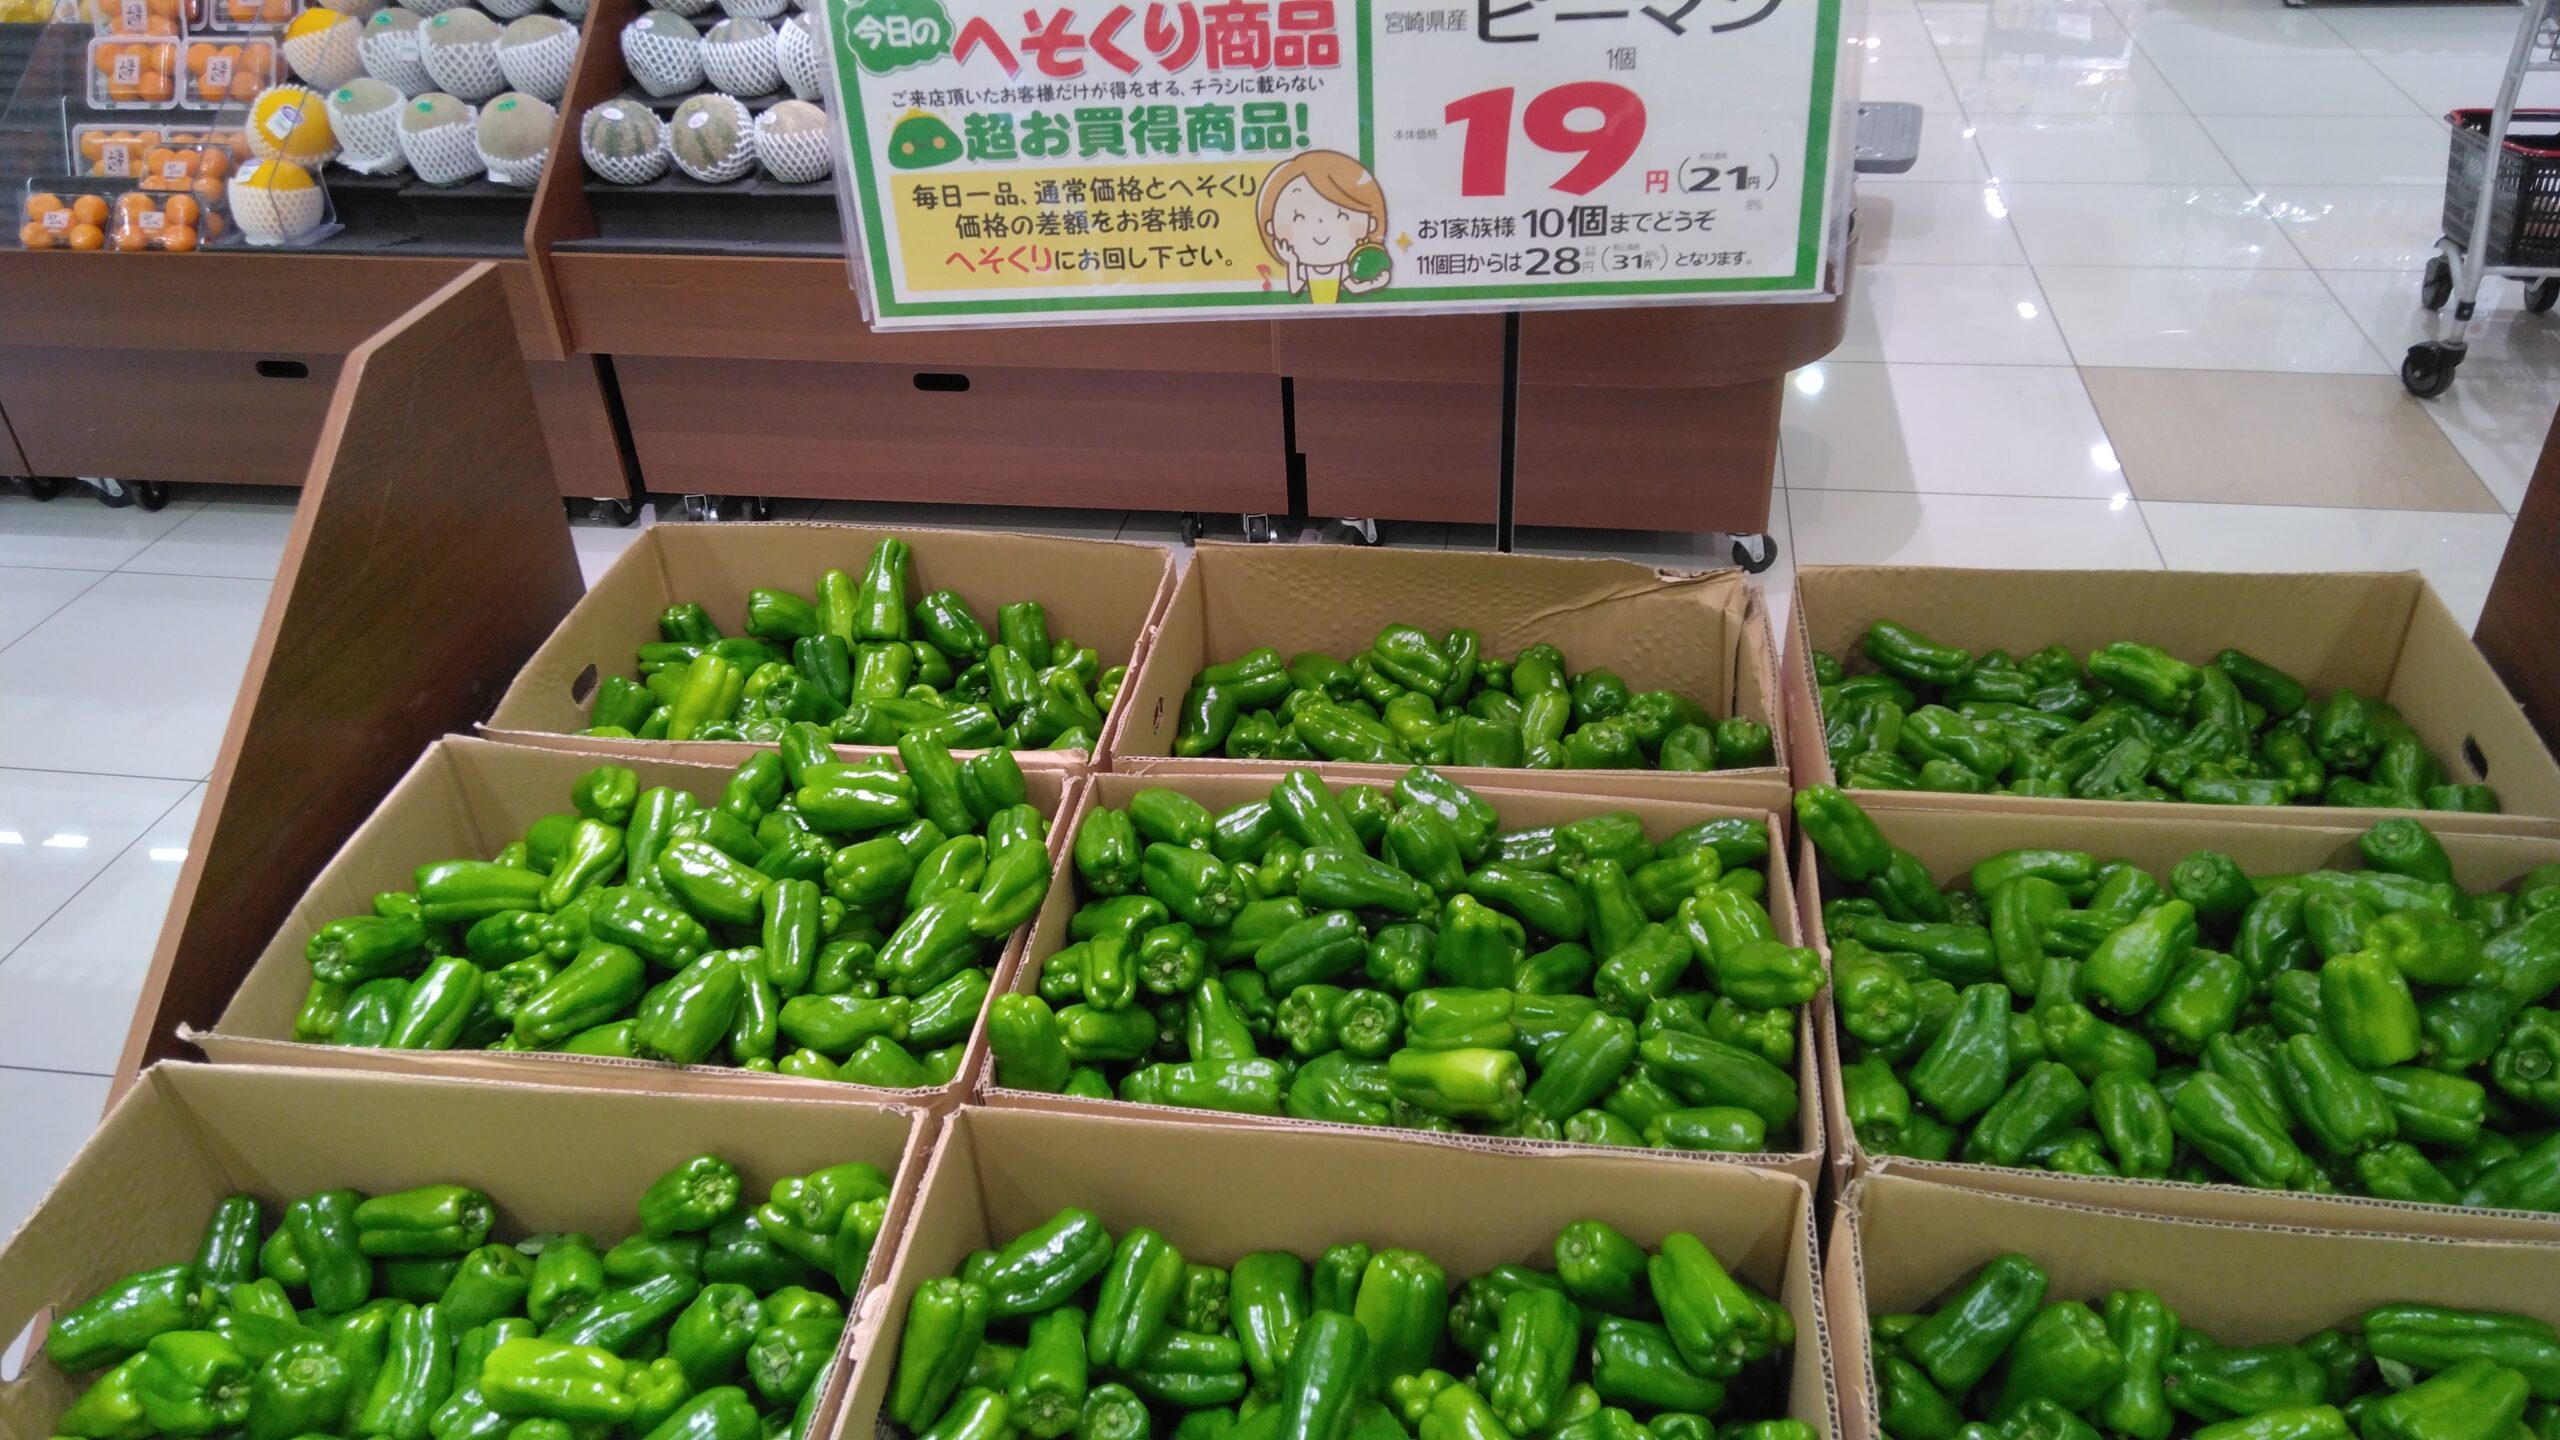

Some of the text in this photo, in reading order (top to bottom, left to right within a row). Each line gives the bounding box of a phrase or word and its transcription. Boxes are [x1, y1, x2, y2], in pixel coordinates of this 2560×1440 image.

[1385, 9, 1468, 34] 宮崎県産
[854, 0, 1340, 79] 今日の へそくり商品
[1606, 47, 1637, 71] 1個
[892, 75, 1325, 108] ご来店頂いたお客様だけが得をする、チラシに載らない
[1394, 127, 1438, 141] 本体価格
[1445, 81, 1647, 196] 19
[1645, 169, 1670, 194] 円
[912, 174, 1257, 210] 毎日一品、通常価格とへそくり
[955, 205, 1220, 240] 価格の差額をお客様の
[945, 244, 1234, 274] へそくりにお回し下さい。
